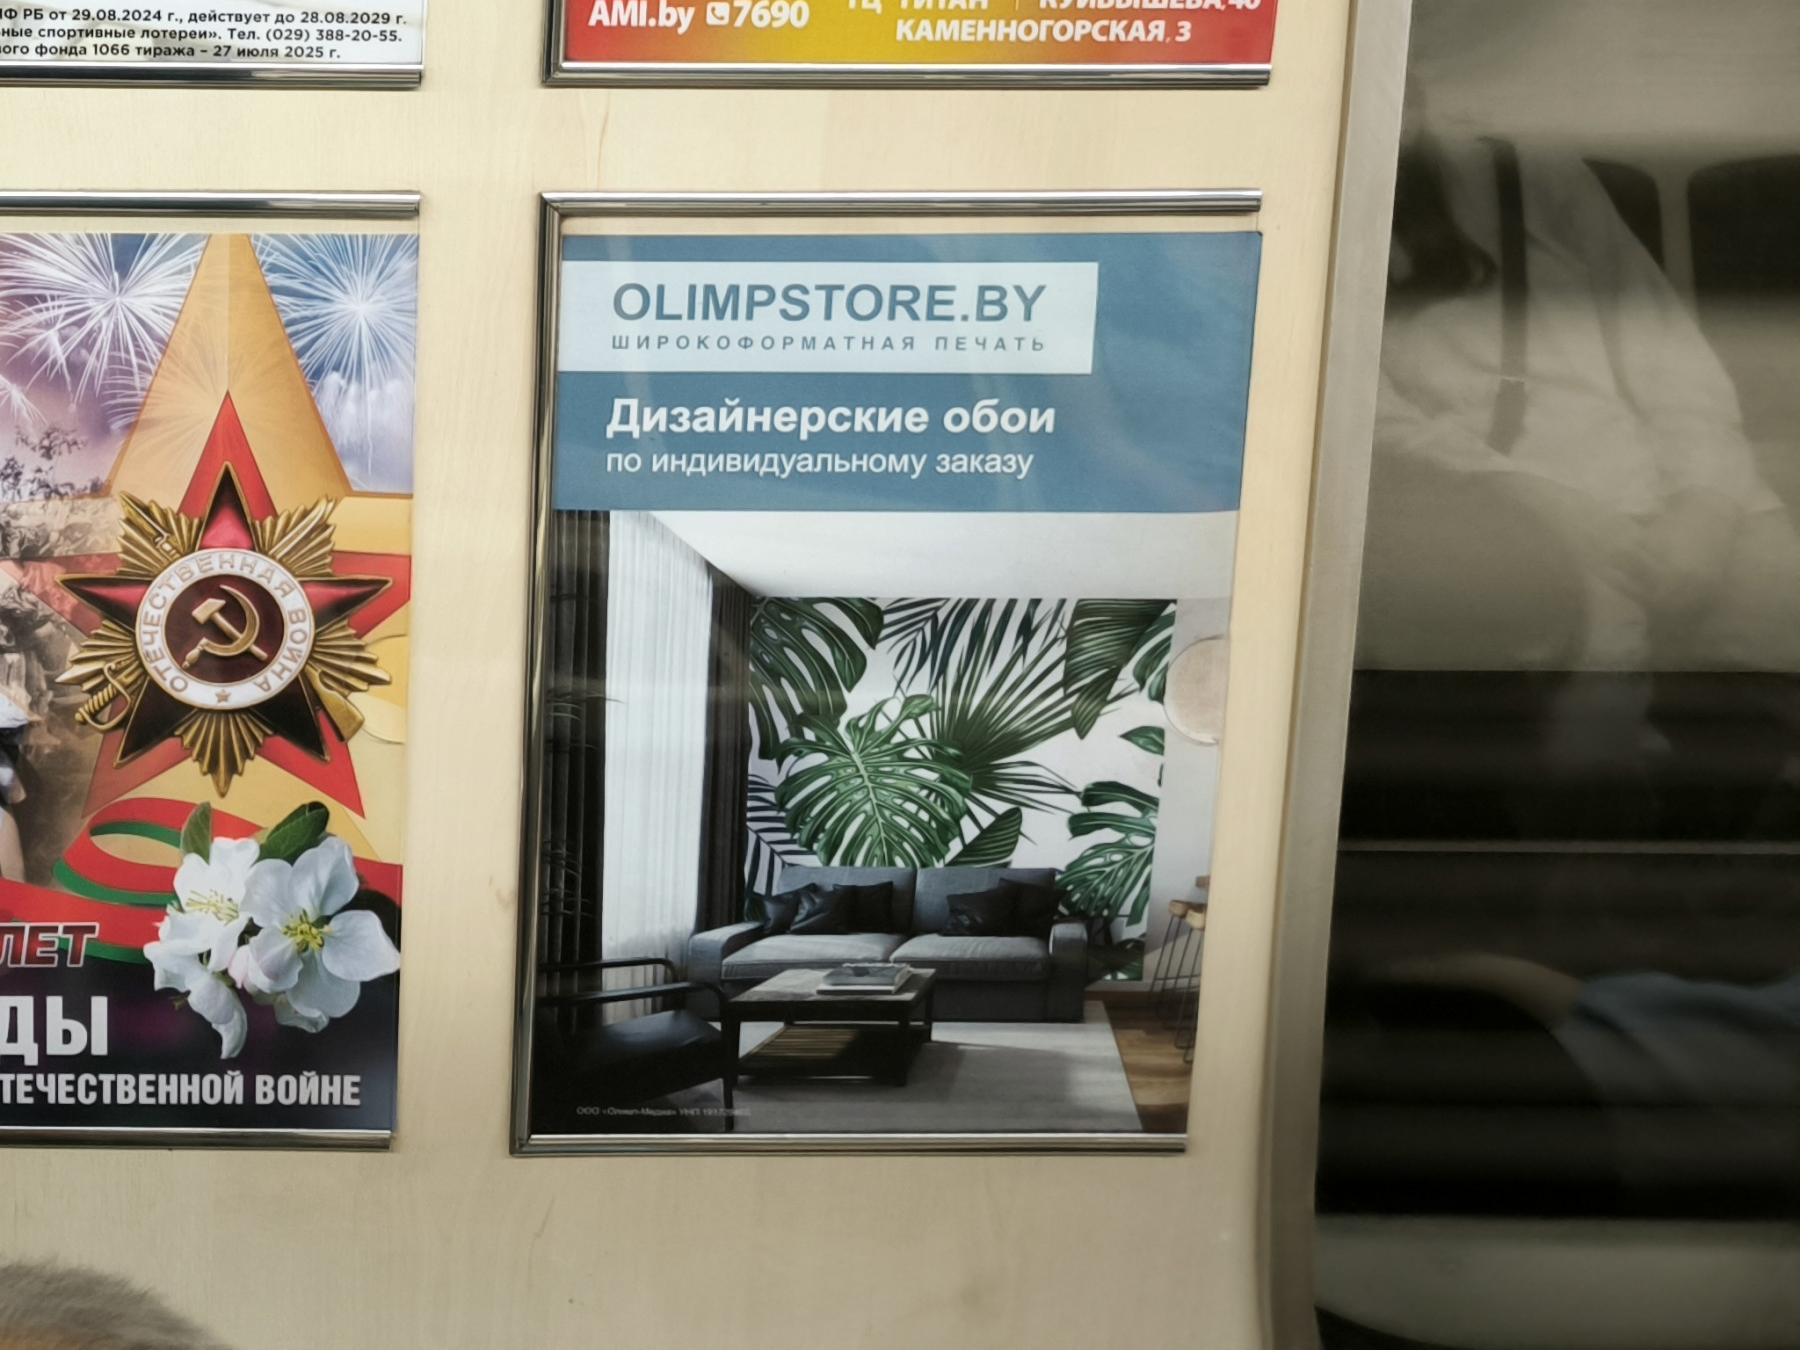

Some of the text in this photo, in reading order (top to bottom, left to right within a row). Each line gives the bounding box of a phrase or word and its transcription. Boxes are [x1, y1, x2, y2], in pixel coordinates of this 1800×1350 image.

[589, 0, 810, 32] AMI.by 7690
[896, 19, 1191, 43] КАМЕННОГОРСКАЯ, 3
[35, 43, 87, 57] фонда
[93, 43, 129, 56] 1066
[134, 46, 195, 58] тиража
[213, 45, 232, 57] 27
[237, 48, 279, 57] июля
[284, 45, 323, 58] 2025
[329, 49, 340, 58] г.
[614, 283, 1046, 322] OLIMPSTORE.BY
[612, 334, 1044, 351] ШИРОКОФОРМАТНАЯ ПЕЧАТЬ
[606, 398, 1055, 436] Дизайнерские обои
[607, 452, 1033, 478] по индивидуальному заказу
[142, 551, 308, 694] ОТЕЧЕСТВЕННАЯ ВОЙНА
[255, 1072, 360, 1106] ВОЙНЕ
